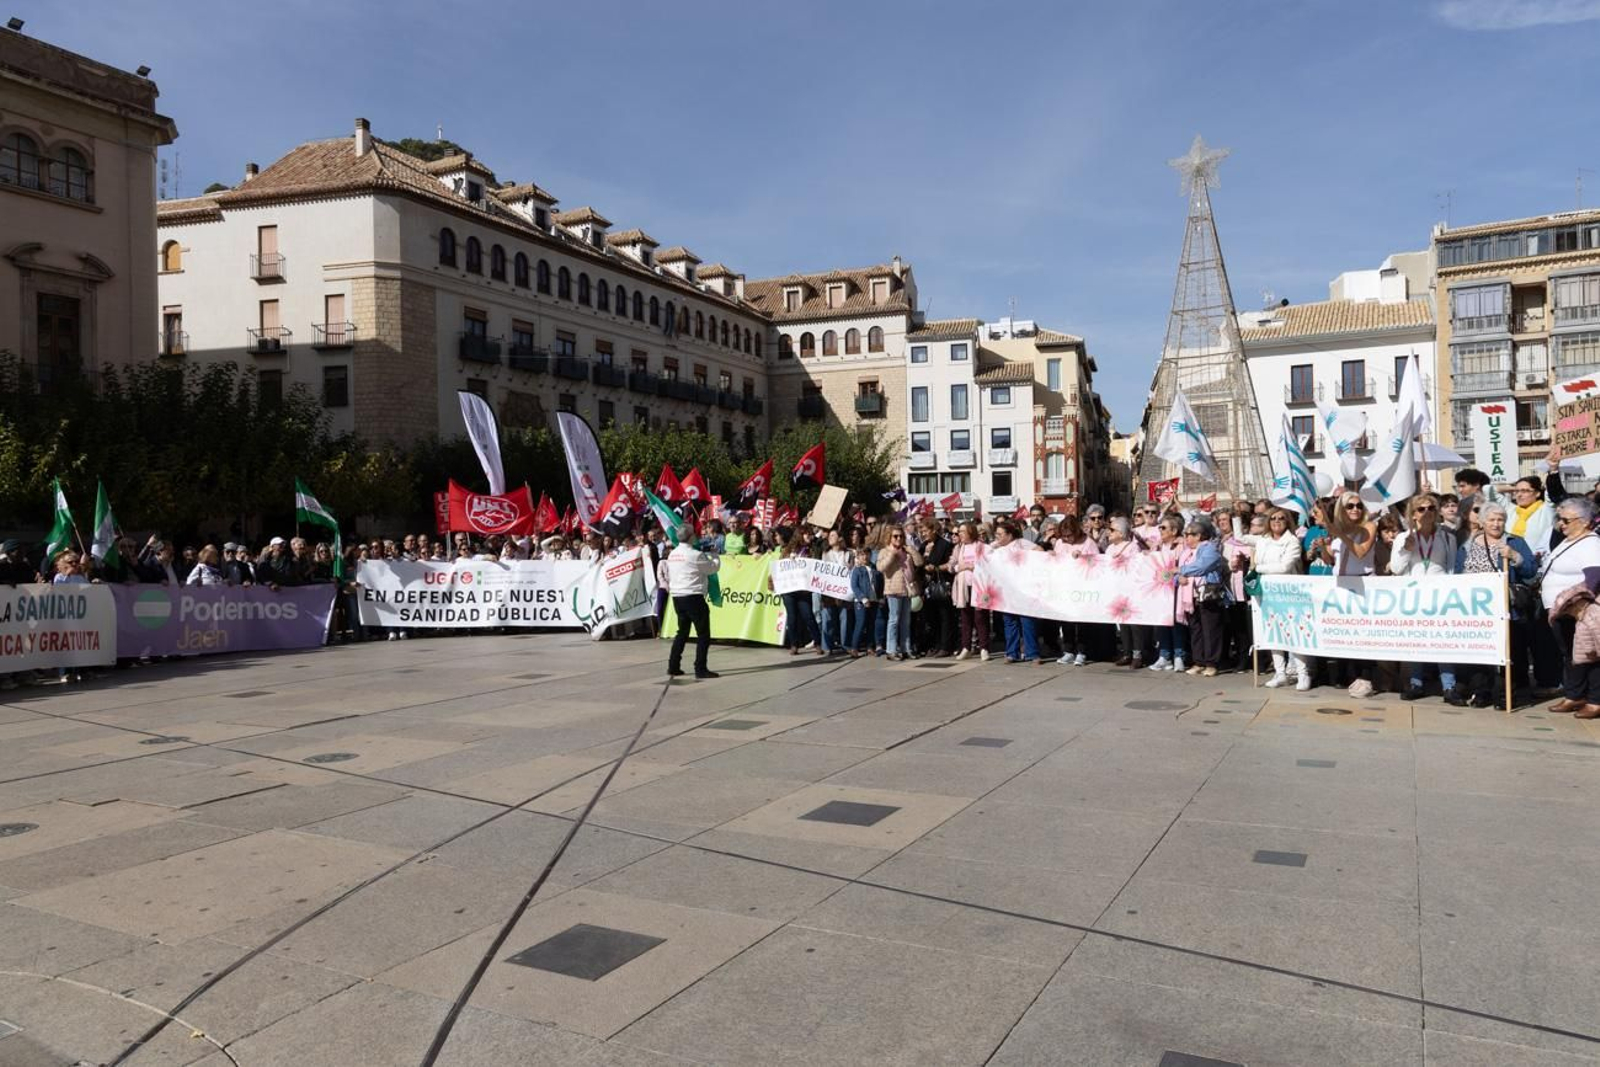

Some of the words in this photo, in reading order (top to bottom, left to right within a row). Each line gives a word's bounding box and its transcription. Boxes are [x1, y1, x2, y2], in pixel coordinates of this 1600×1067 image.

[1558, 403, 1575, 420] SIN
[1488, 416, 1504, 475] USTEA
[1560, 439, 1588, 456] MADRE
[608, 563, 635, 578] CCOO
[364, 588, 387, 603] EN
[394, 590, 477, 604] DEFENSA
[482, 589, 503, 603] DE
[1321, 580, 1494, 616] ANDÚJAR
[15, 594, 87, 621] SANIDAD
[179, 595, 299, 622] Podemos
[399, 608, 480, 622] SANIDAD
[486, 603, 562, 621] PÚBLICA
[1321, 618, 1372, 626] ASOCIACIÓN
[1374, 618, 1415, 627] ANDÚJAR
[1417, 619, 1436, 627] POR
[1451, 619, 1494, 628] SANIDAD
[28, 631, 36, 653] Y
[39, 630, 100, 652] GRATUITA
[1322, 627, 1351, 636] APOYA
[1407, 630, 1428, 638] POR
[1430, 630, 1443, 638] LA
